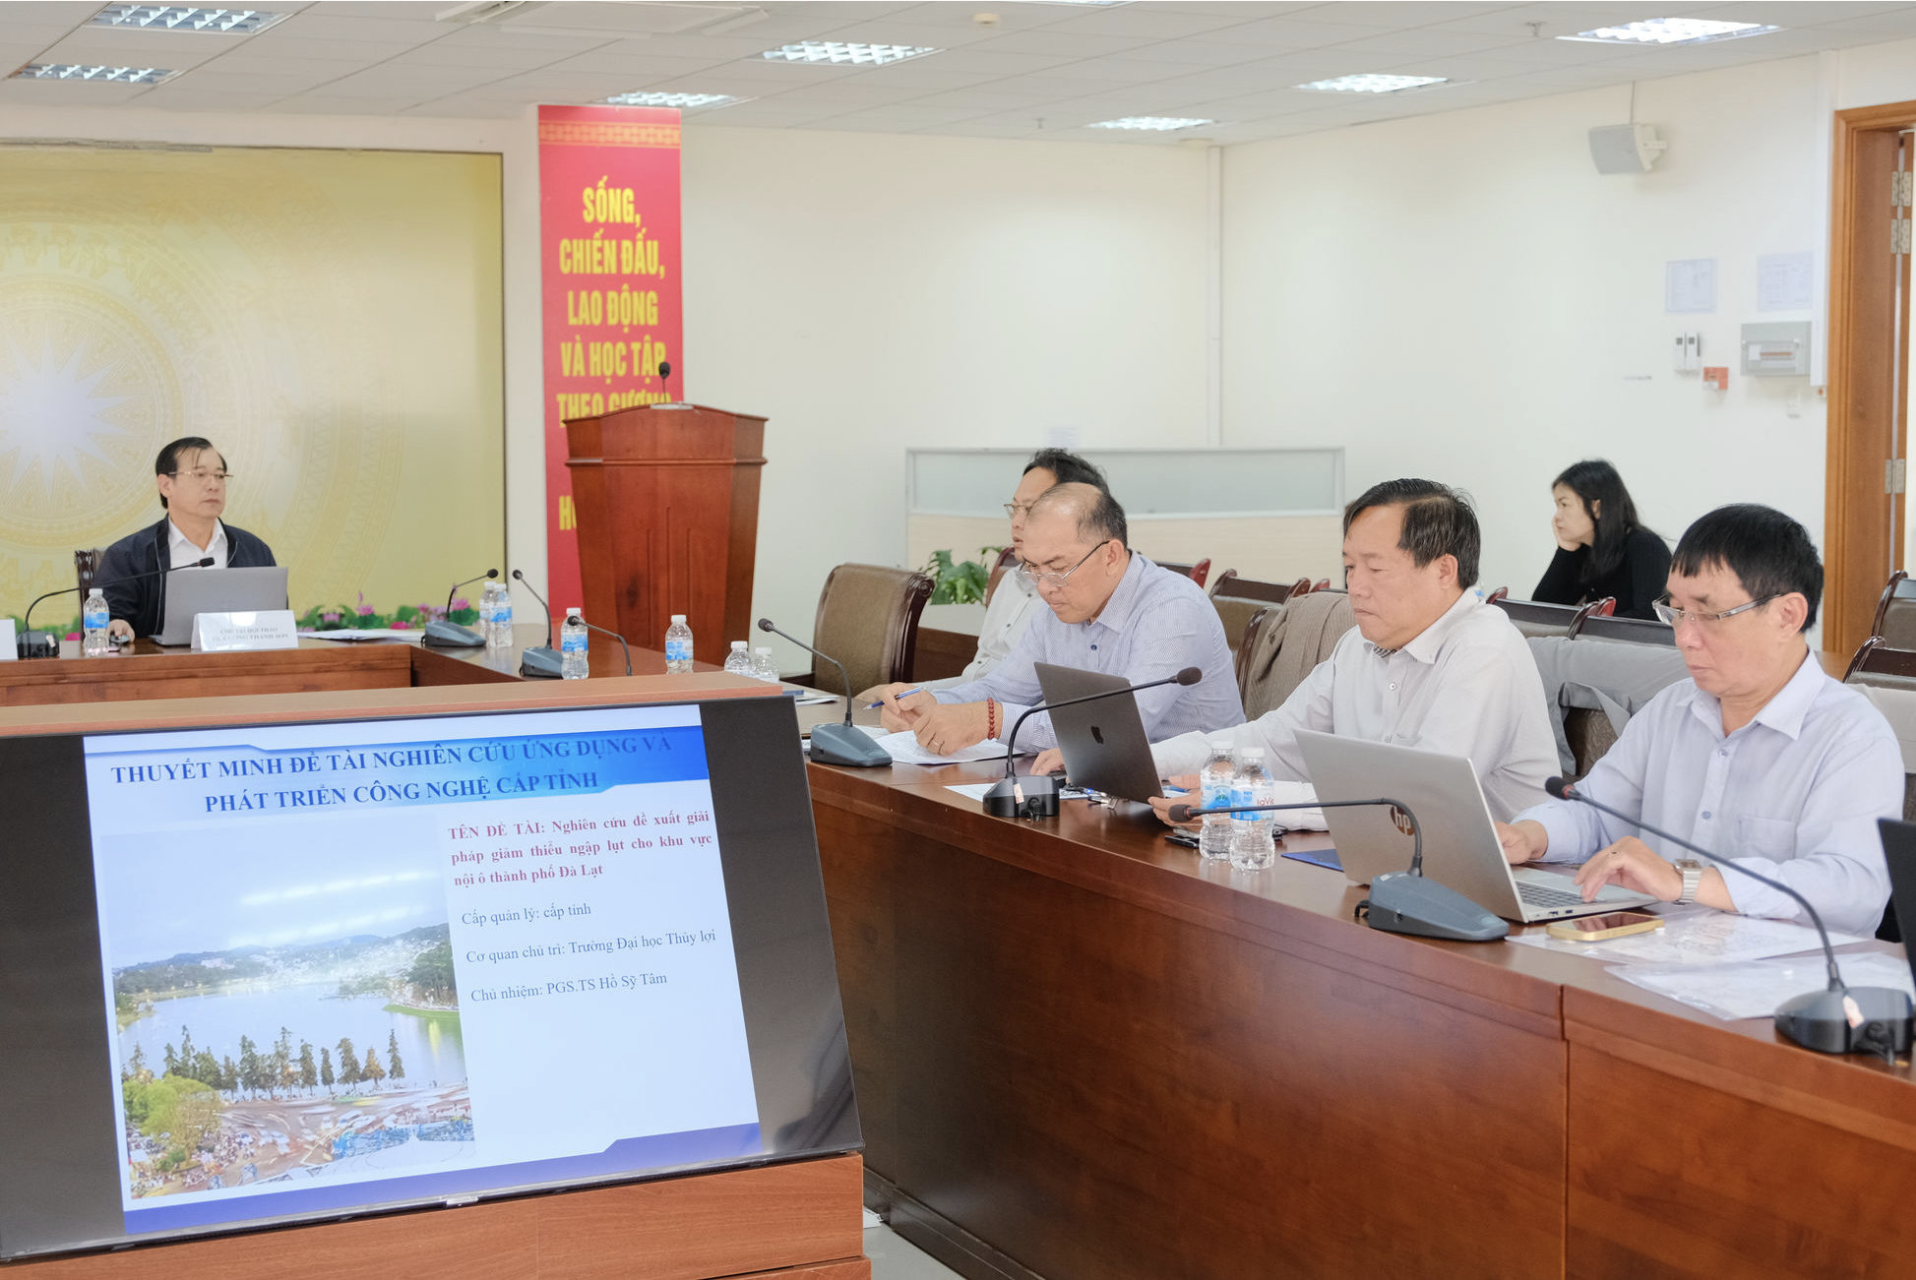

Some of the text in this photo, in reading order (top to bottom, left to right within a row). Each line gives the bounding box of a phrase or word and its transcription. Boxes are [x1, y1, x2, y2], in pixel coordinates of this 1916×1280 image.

[582, 175, 641, 228] SỐNG,
[559, 228, 665, 279] CHIẾN ĐẤU,
[567, 283, 658, 334] LAO ĐỘNG
[560, 334, 666, 385] VÀ HỌC TẬP
[110, 731, 672, 784] THUYẾT MINH ĐỀ TÀI NGHIÊN CỨU ỨNG DỤNG VÀ
[205, 768, 599, 813] PHÁT TRIỂN CÔNG NGHỆ CẤP TỈNH
[447, 810, 710, 840] TÊN ĐỀ TÀI: Nghiên cứu đề xuất giải
[1393, 805, 1411, 836] hp
[451, 835, 713, 866] pháp giảm thiểu ngập lụt cho khu vực
[454, 864, 603, 888] nội ô thành phố Đà Lạt
[461, 902, 592, 927] Cấp quản lý: cấp tỉnh
[466, 929, 716, 964] Cơ quan chủ trì: Trường Đại học Thủy lợi
[470, 971, 667, 1002] Chủ nhiệm: PGS.TS Hồ Sỹ Tâm
